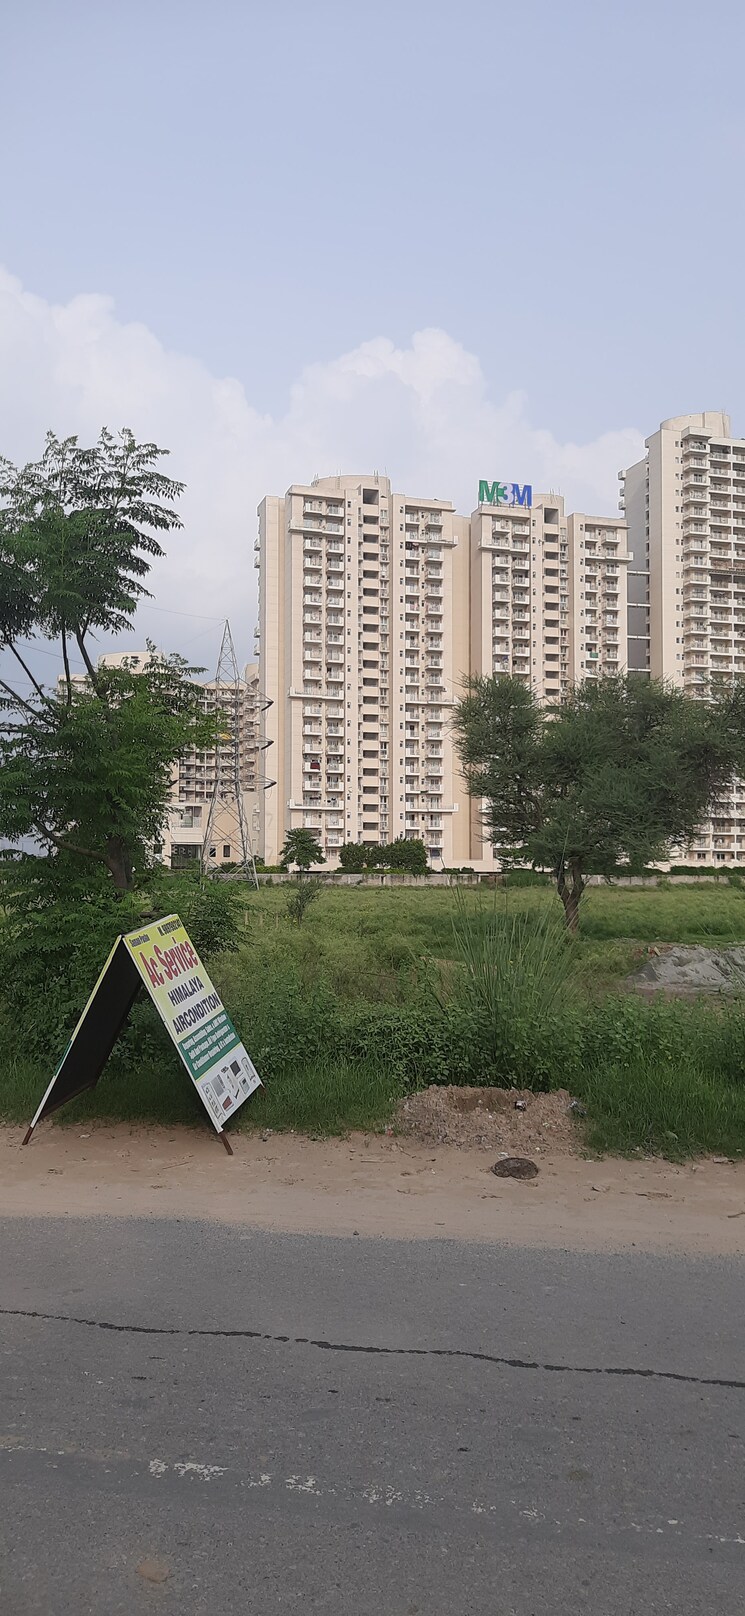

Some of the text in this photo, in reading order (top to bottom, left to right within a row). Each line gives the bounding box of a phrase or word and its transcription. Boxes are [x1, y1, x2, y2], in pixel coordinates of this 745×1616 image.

[478, 479, 532, 507] M3M
[139, 936, 199, 989] Ac Service
[167, 975, 205, 1007] HIMALAYA
[172, 992, 221, 1036] AIRCONDITION
